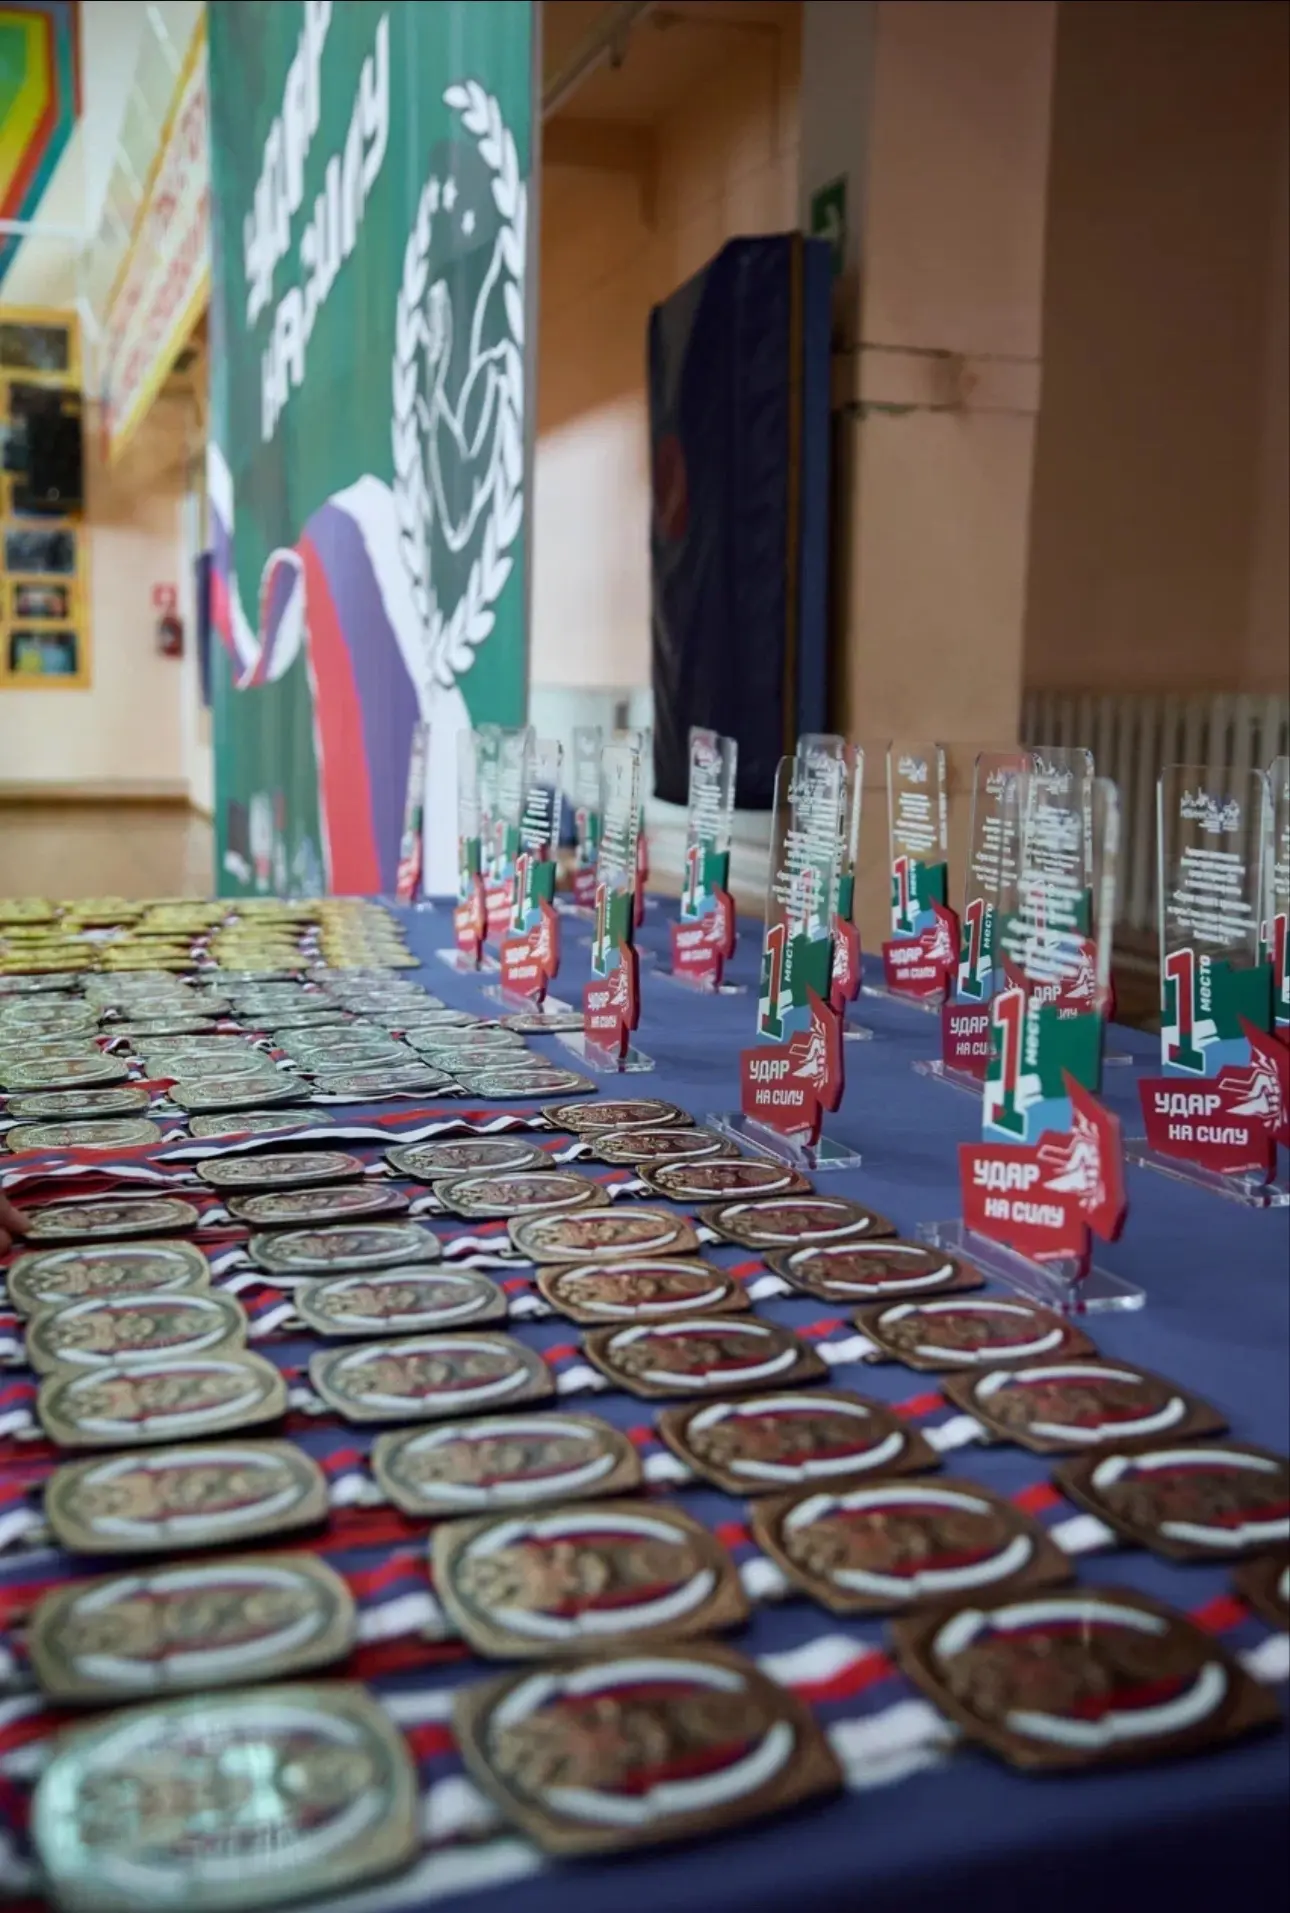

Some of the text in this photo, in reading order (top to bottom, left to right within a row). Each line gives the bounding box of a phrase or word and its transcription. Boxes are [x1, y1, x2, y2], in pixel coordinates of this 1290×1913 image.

[892, 854, 914, 935] 1
[957, 897, 985, 1001] 1
[758, 923, 786, 1042] 1
[1033, 986, 1062, 1001] ДАР
[950, 1016, 989, 1037] УДАР
[1165, 948, 1206, 1076] 1
[956, 1042, 971, 1056] НА
[749, 1059, 790, 1084] УДАР
[991, 987, 1029, 1142] 1
[756, 1089, 804, 1107] НА СИЛУ
[1155, 1092, 1221, 1119] УДАР
[1168, 1124, 1248, 1146] НА СИЛУ
[973, 1158, 1041, 1192] УДАР
[984, 1197, 1065, 1229] НА СИЛУ
